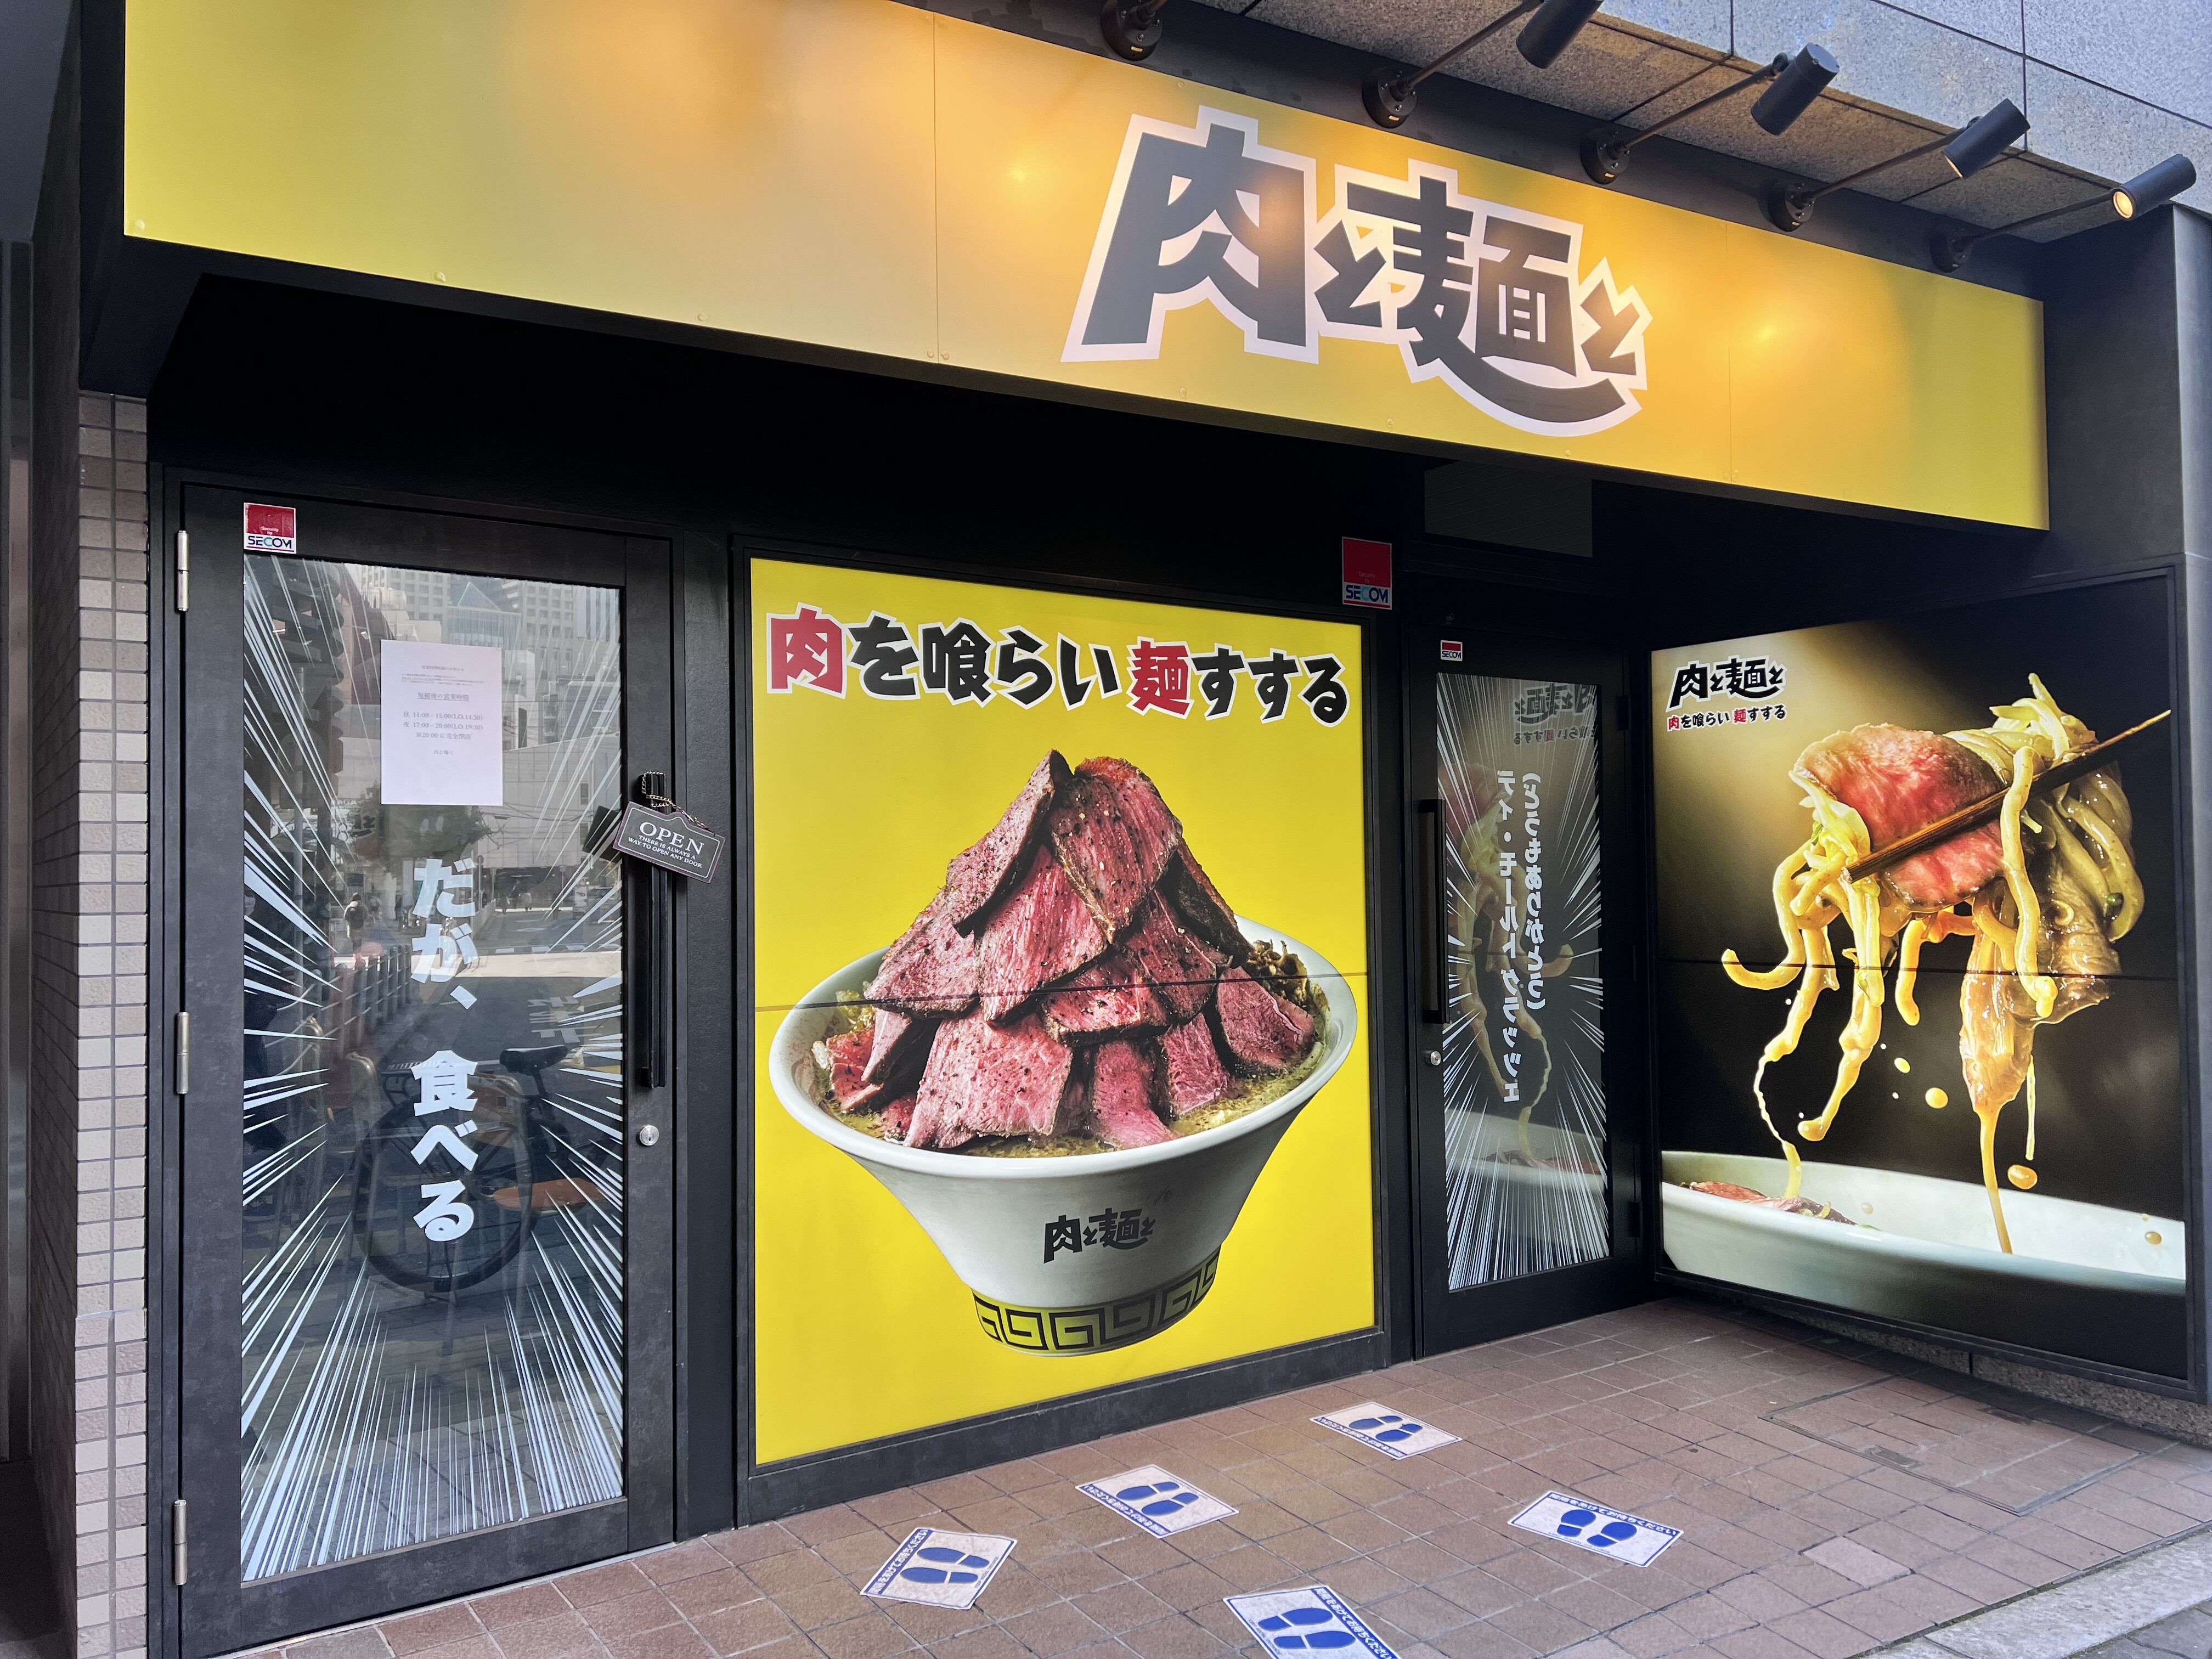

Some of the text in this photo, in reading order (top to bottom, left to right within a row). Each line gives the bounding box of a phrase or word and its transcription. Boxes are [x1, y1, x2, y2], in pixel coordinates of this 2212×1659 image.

[1078, 122, 1643, 425] 肉と麺と
[247, 535, 292, 549] SECOM
[1346, 584, 1389, 603] SECOM
[1442, 651, 1462, 659] SECOM
[1669, 657, 1784, 709] 肉と麺と
[628, 837, 642, 846] WAY
[652, 847, 670, 856] OPEN
[670, 853, 684, 861] ANY
[639, 834, 658, 846] THERE
[666, 846, 691, 857] ALWAYS
[640, 822, 705, 855] OPEN
[1043, 1207, 1156, 1264] 肉と麺と
